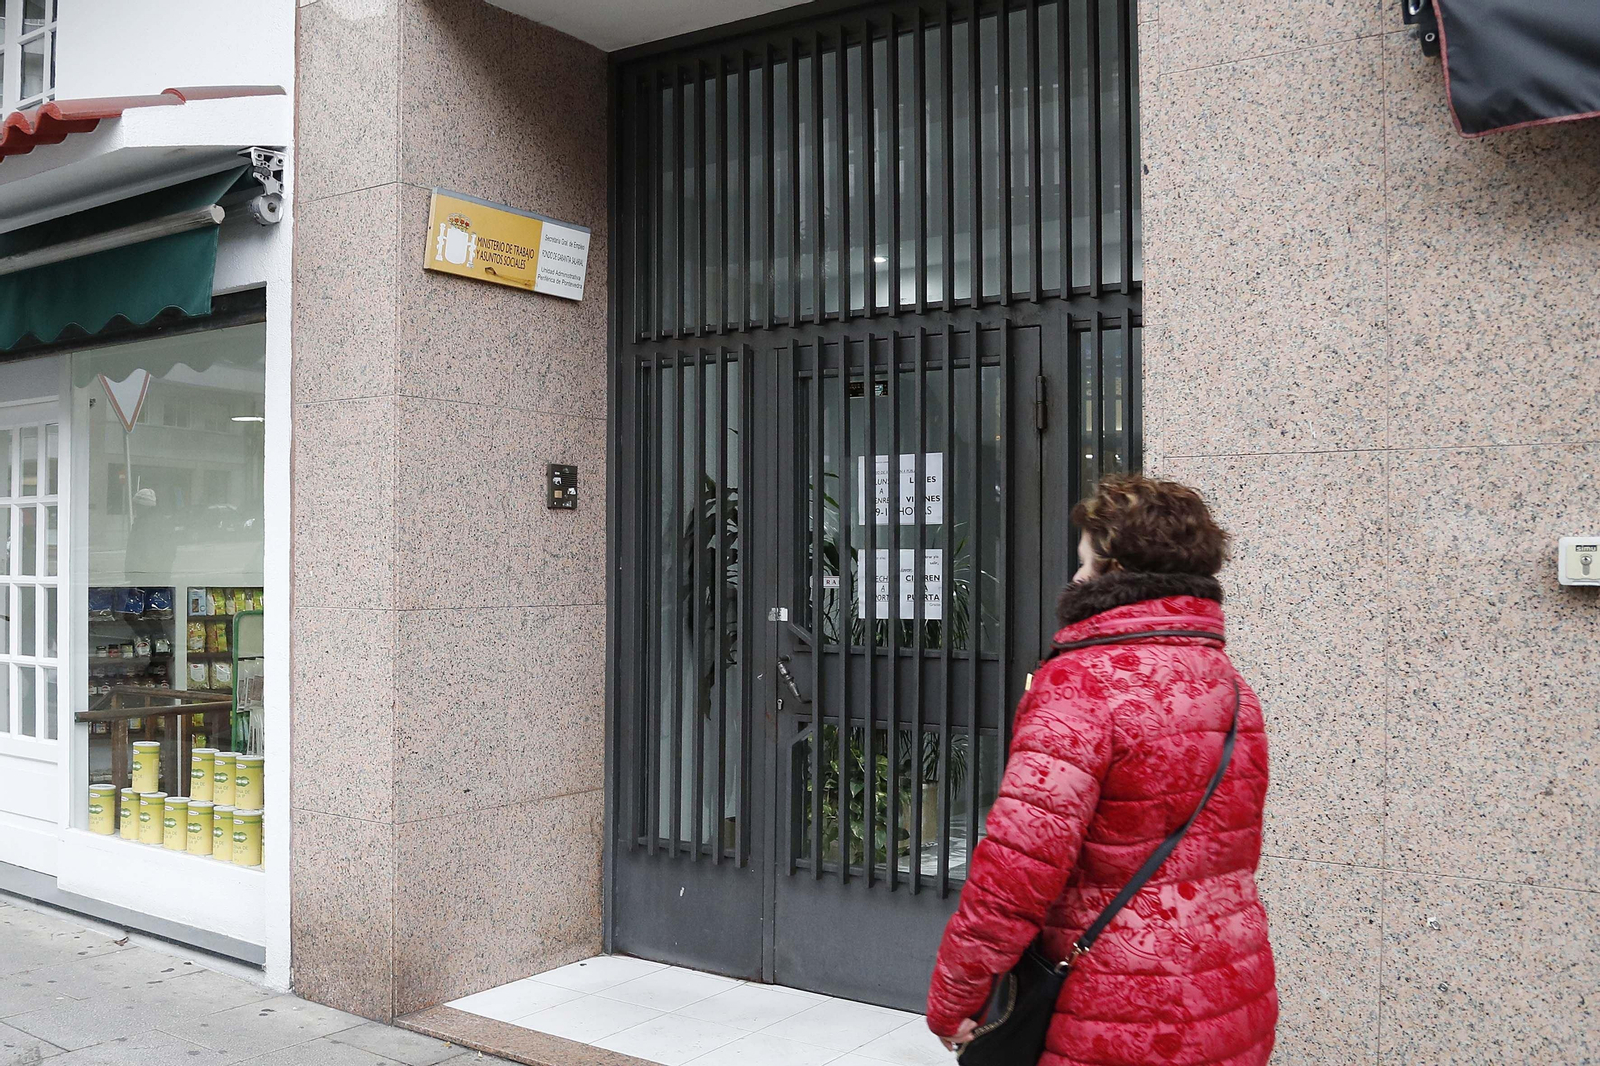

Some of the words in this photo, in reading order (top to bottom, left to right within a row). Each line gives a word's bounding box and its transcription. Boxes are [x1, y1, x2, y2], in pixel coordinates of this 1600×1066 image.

[477, 236, 505, 252] MINISTERIO
[506, 243, 513, 254] DE
[514, 245, 535, 261] TRABAJO
[574, 241, 585, 250] Empleo
[476, 249, 480, 259] Y
[480, 250, 503, 265] ASUNTOS
[503, 255, 526, 270] SOCIALES
[540, 266, 555, 275] Unidad
[555, 270, 581, 281] Administrativa
[561, 279, 583, 289] Pontevedra
[909, 475, 936, 484] LES
[906, 495, 940, 503] VINES
